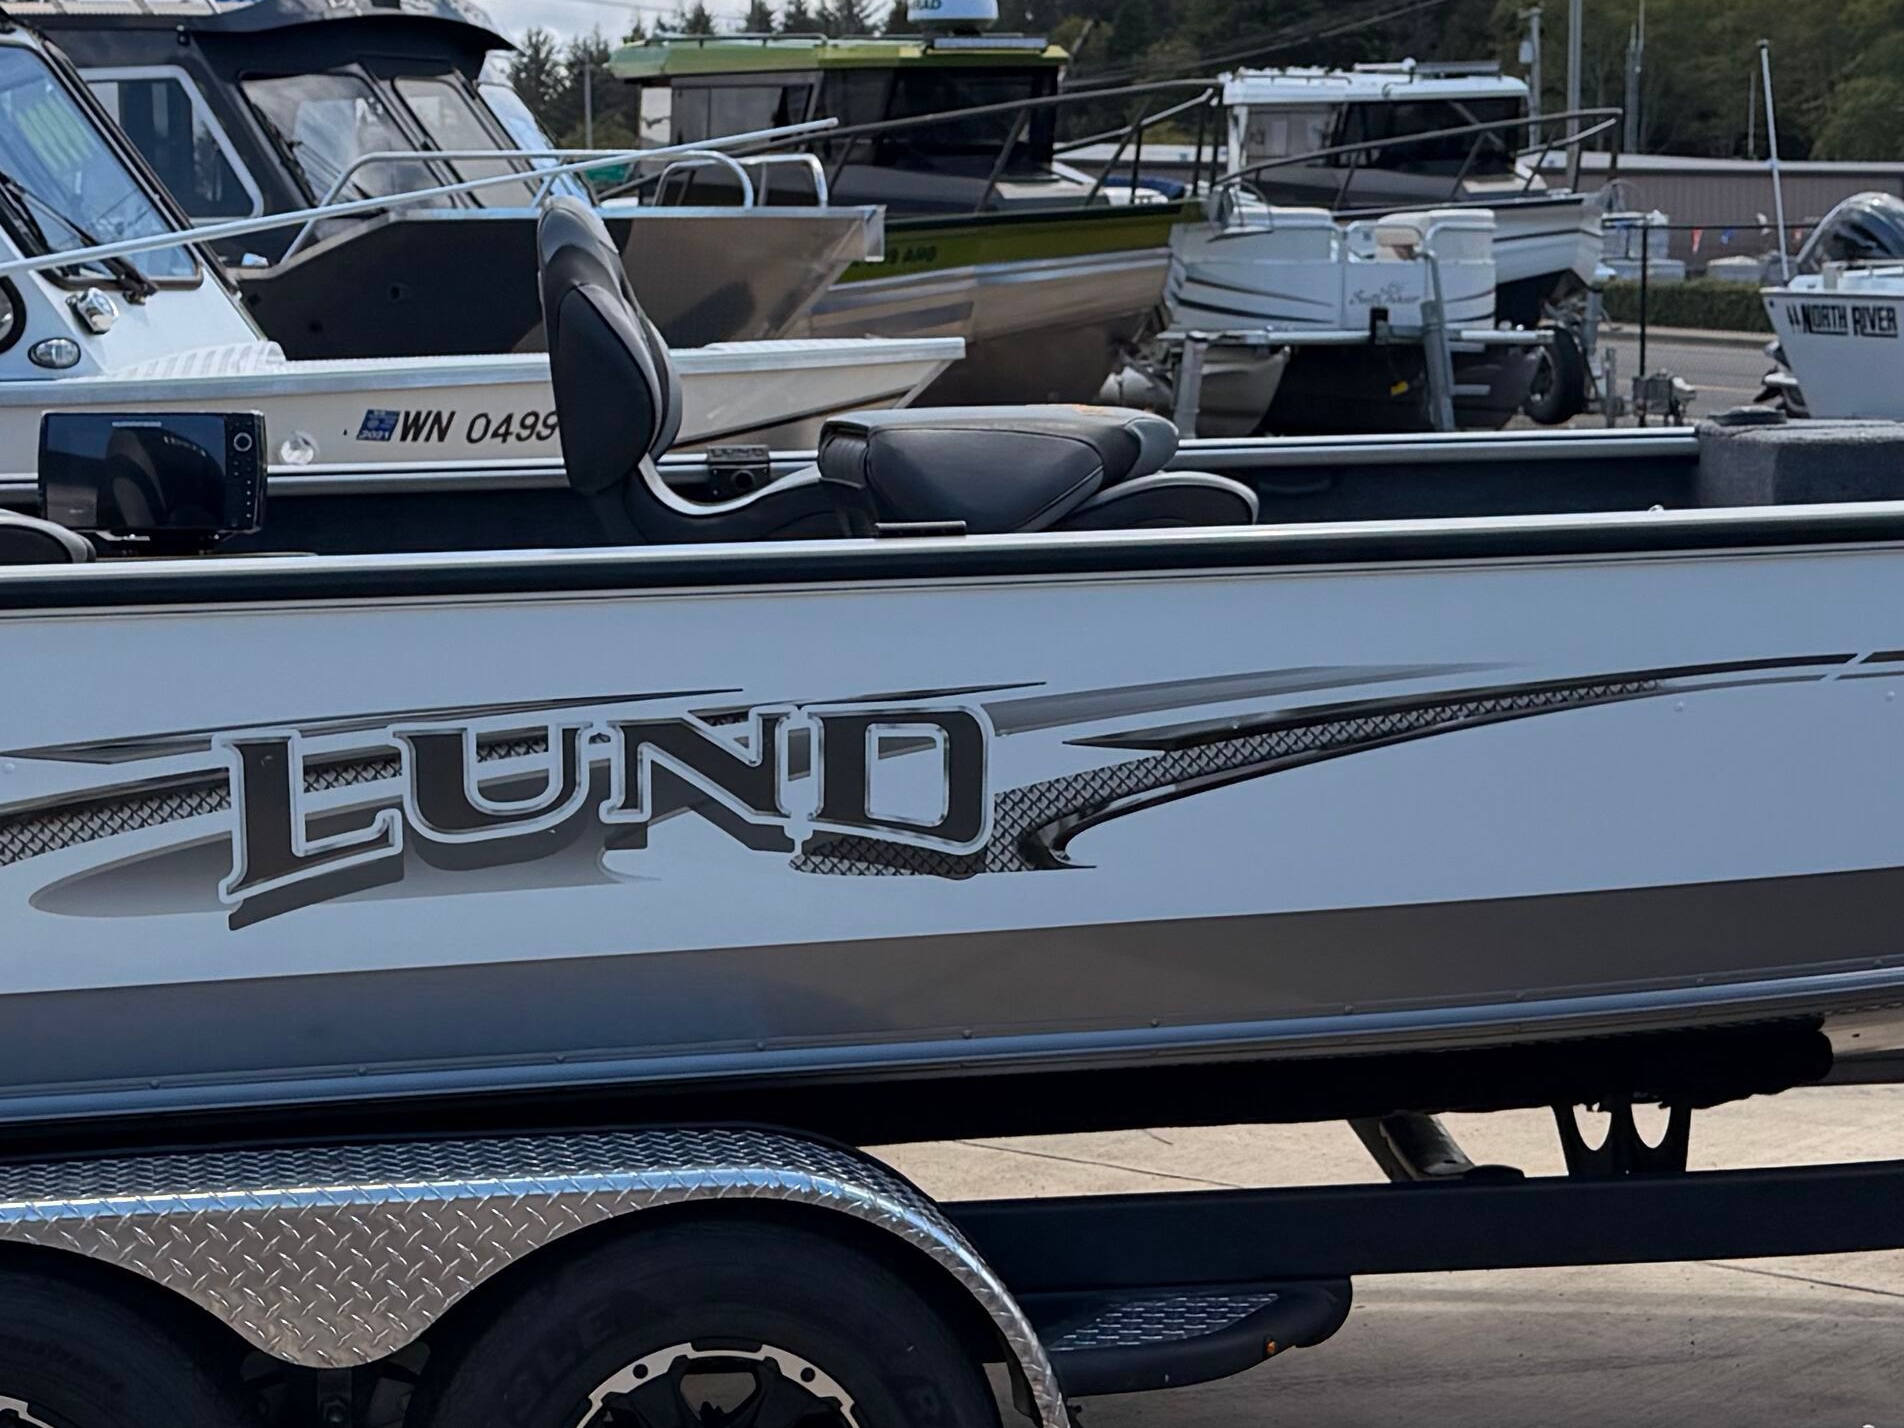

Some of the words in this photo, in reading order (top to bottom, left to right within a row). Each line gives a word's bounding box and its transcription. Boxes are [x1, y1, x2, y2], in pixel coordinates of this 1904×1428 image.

[1799, 303, 1849, 336] NORTH
[1850, 305, 1899, 339] RIVER
[399, 410, 456, 443] WN
[465, 409, 560, 444] 0499
[213, 703, 995, 917] LUND
